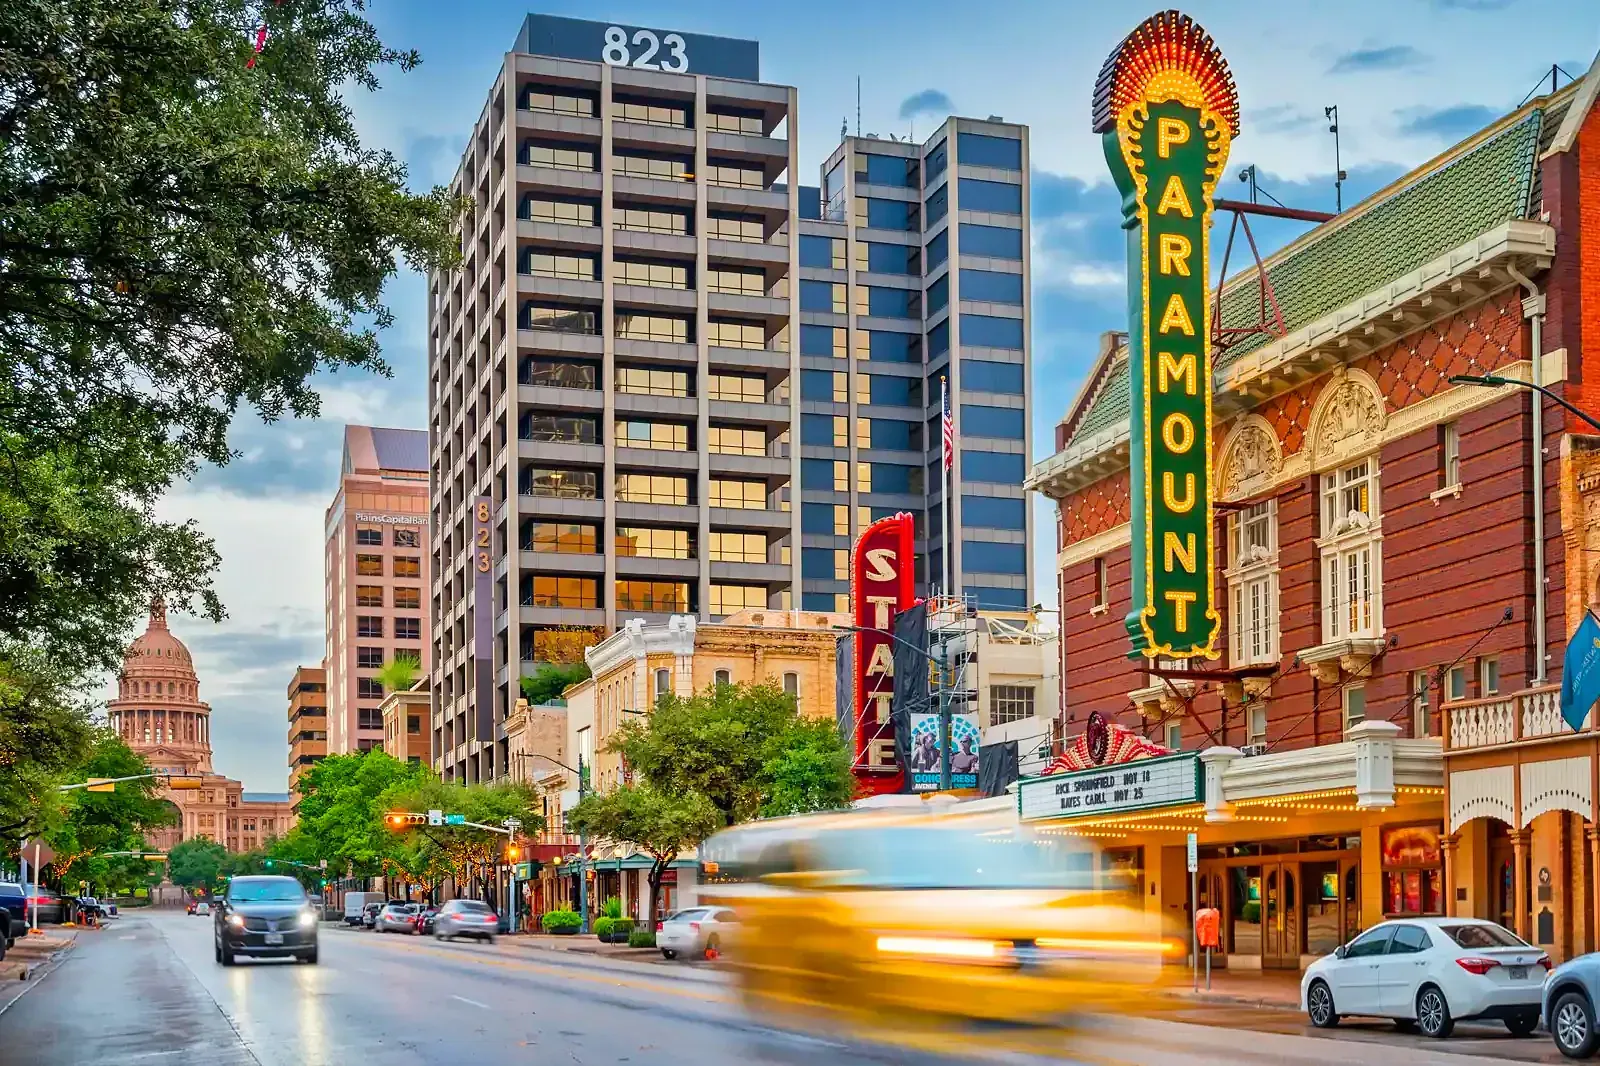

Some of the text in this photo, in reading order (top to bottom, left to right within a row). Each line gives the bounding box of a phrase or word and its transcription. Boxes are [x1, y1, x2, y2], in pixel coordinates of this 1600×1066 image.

[602, 26, 689, 74] 823
[1157, 117, 1197, 632] PARAMOUNT
[477, 503, 490, 572] 823
[866, 549, 899, 772] STATE
[1074, 776, 1115, 792] SPRINGFIELD
[1134, 787, 1143, 799] 25
